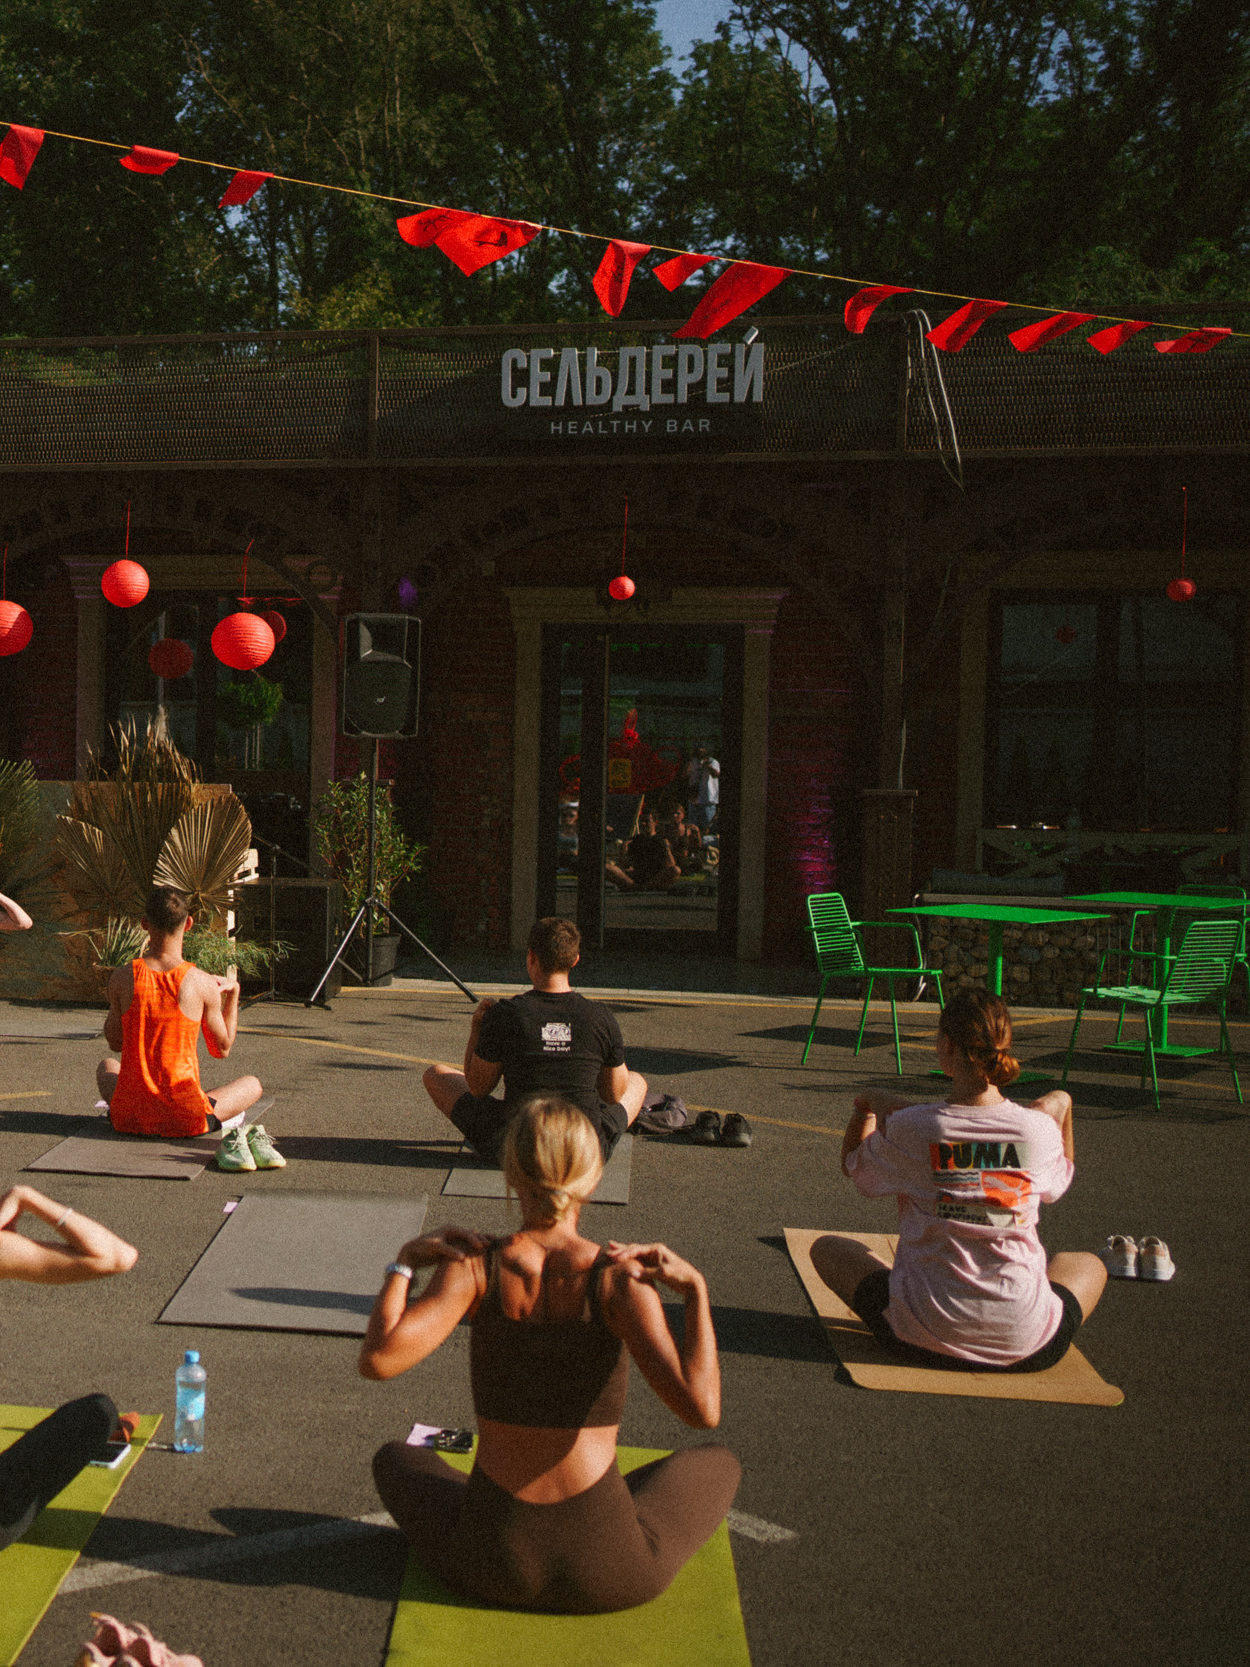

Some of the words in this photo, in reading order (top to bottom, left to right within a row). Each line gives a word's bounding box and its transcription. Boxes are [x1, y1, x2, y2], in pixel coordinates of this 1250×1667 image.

[501, 326, 765, 412] СЕЛЬДЕРЕЙ
[550, 420, 653, 434] HEALTHY
[666, 418, 711, 432] BAR
[939, 1142, 1021, 1169] PUMA
